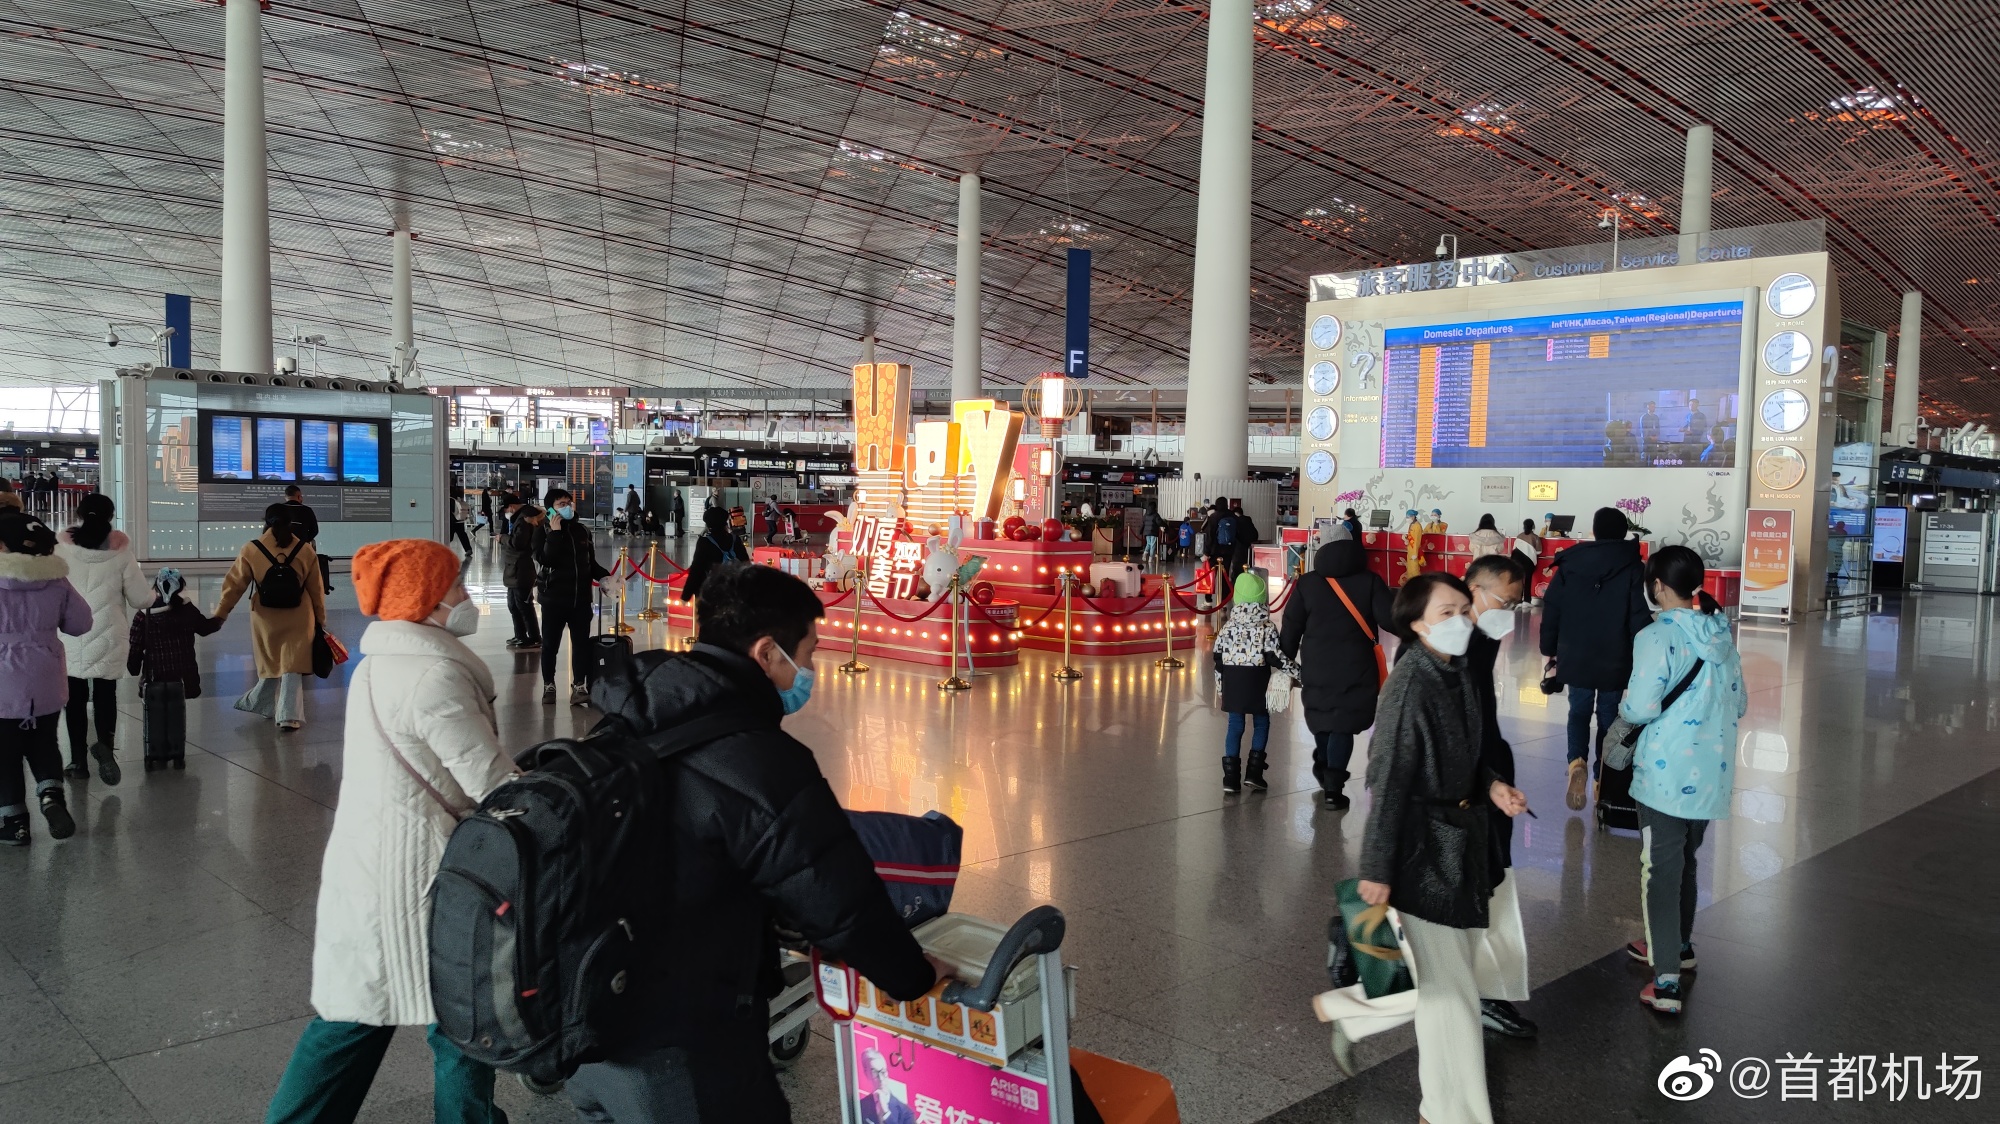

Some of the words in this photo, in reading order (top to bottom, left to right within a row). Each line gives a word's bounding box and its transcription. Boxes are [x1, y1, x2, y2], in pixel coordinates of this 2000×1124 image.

[1534, 260, 1606, 278] Customer
[1620, 252, 1681, 269] Service
[1696, 245, 1754, 262] Center
[1356, 256, 1519, 298] 旅客服务中心
[1423, 328, 1463, 339] Domestic
[1465, 324, 1513, 337] Departures
[1070, 350, 1084, 373] F
[1360, 415, 1378, 423] 9658
[711, 458, 718, 467] F
[723, 459, 734, 468] 35
[1891, 465, 1898, 479] E
[1927, 515, 1939, 529] E
[990, 1076, 1020, 1096] ARIS
